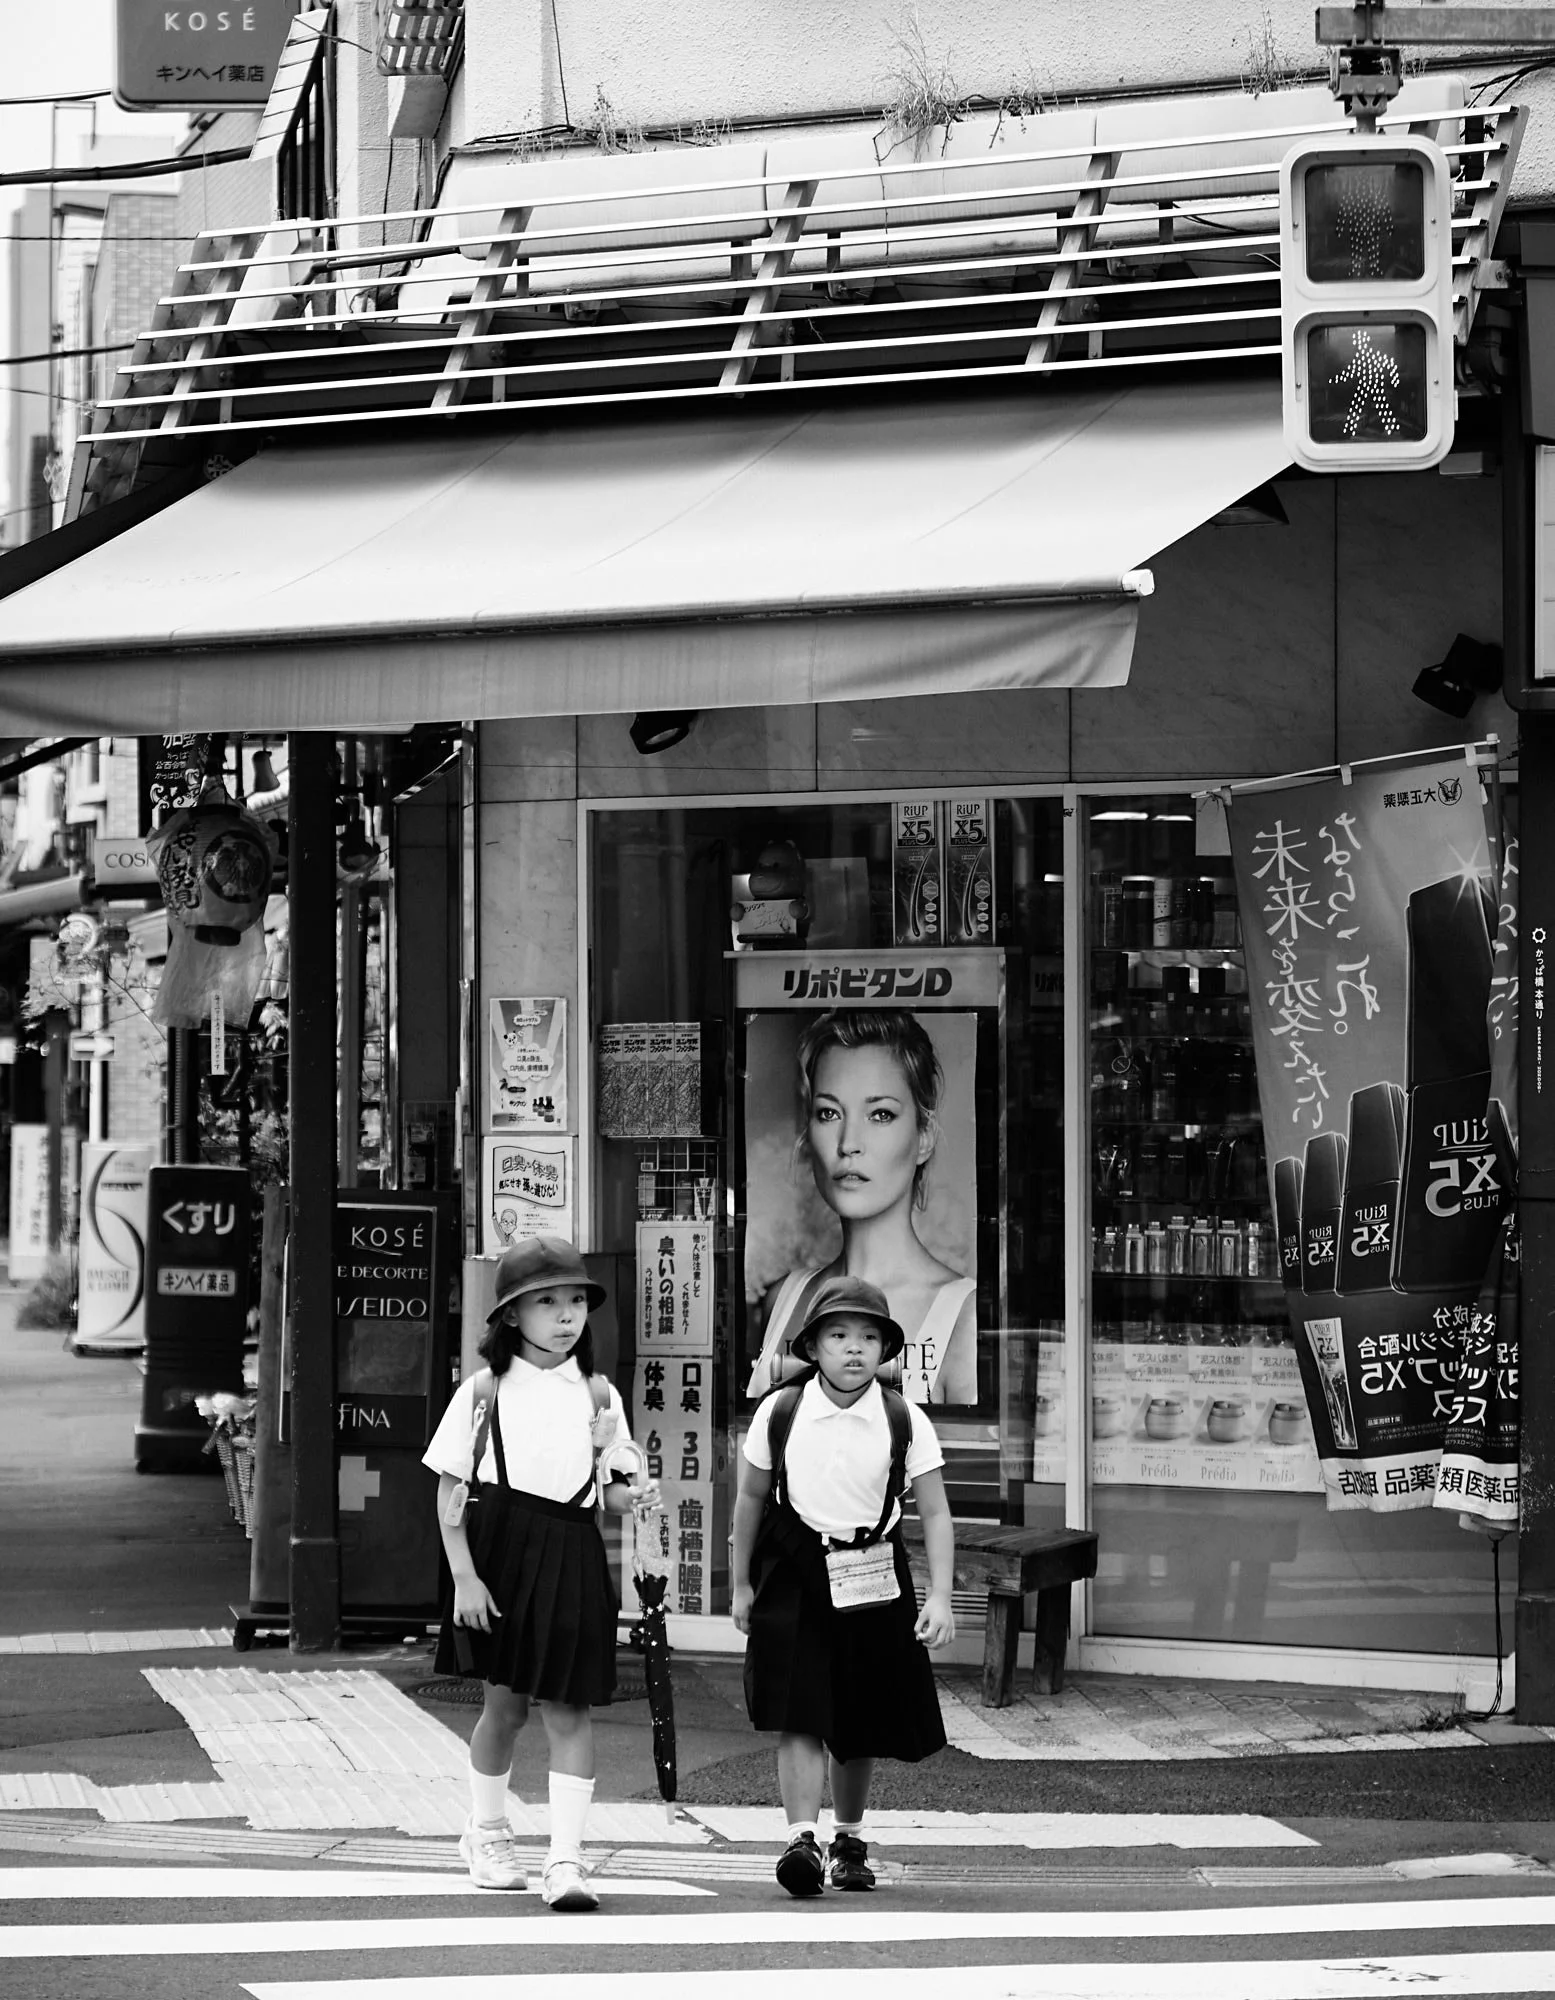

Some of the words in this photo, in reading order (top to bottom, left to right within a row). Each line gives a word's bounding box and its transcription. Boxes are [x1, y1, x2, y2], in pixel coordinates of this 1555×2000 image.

[164, 8, 256, 31] KOSÉ
[156, 65, 265, 83] キンヘイ薬店
[902, 820, 932, 845] X5
[954, 819, 984, 843] X5
[104, 853, 150, 869] COS
[783, 966, 953, 999] リポビタンD
[1535, 948, 1545, 1020] かっぱ橋本通り
[163, 1201, 236, 1235] くすり
[351, 1223, 424, 1248] KOSÉ
[164, 1272, 229, 1292] キンヘイ薬品
[352, 1265, 429, 1280] DECORTE
[658, 1235, 675, 1335] 臭いの相談
[643, 1360, 665, 1412] 体臭
[680, 1362, 702, 1414] 口臭
[646, 1429, 663, 1479] 6日
[680, 1431, 700, 1481] 3日
